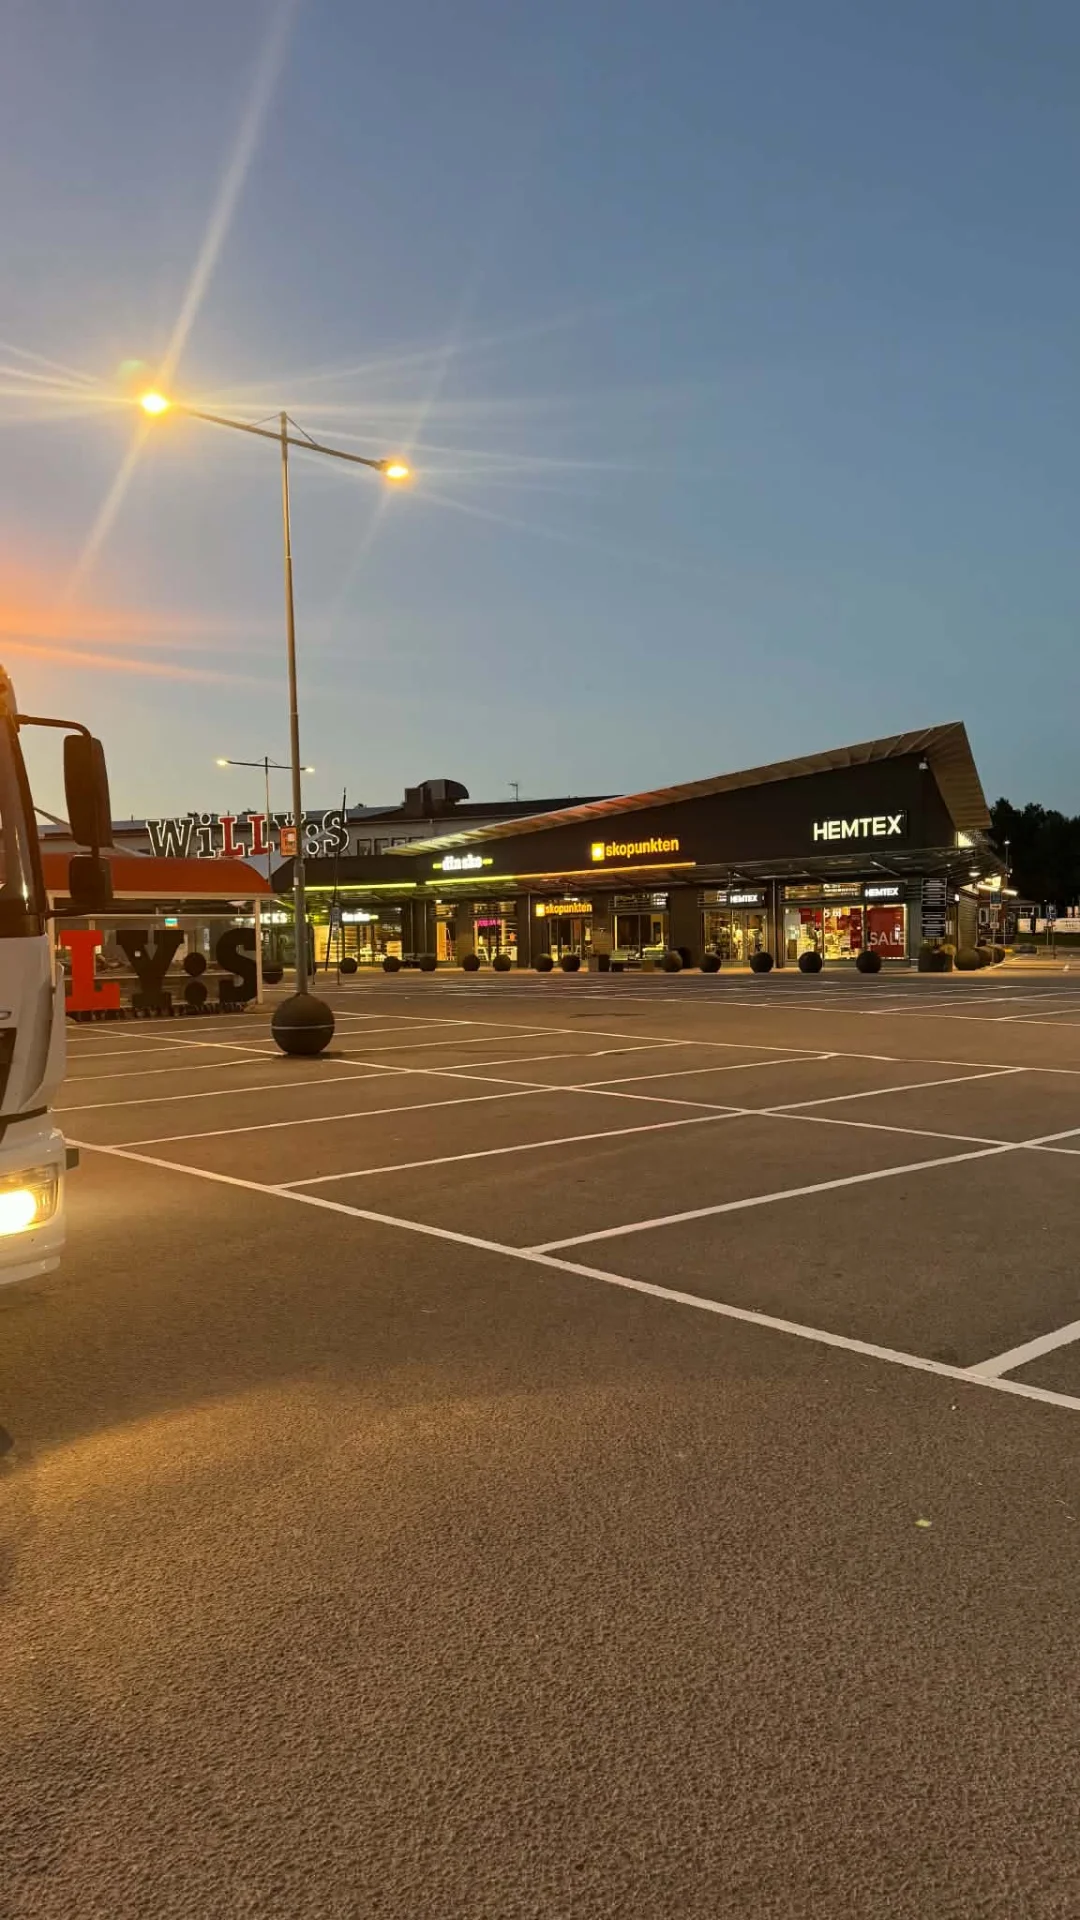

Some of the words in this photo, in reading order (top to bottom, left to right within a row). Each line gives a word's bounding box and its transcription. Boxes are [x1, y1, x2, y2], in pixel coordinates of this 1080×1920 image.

[813, 815, 902, 841] HEMTEX
[606, 838, 679, 858] skopunkten
[730, 894, 758, 903] HEMTEX
[865, 887, 899, 897] HEMTEX
[545, 903, 592, 915] skopunkten
[870, 931, 905, 945] SALE
